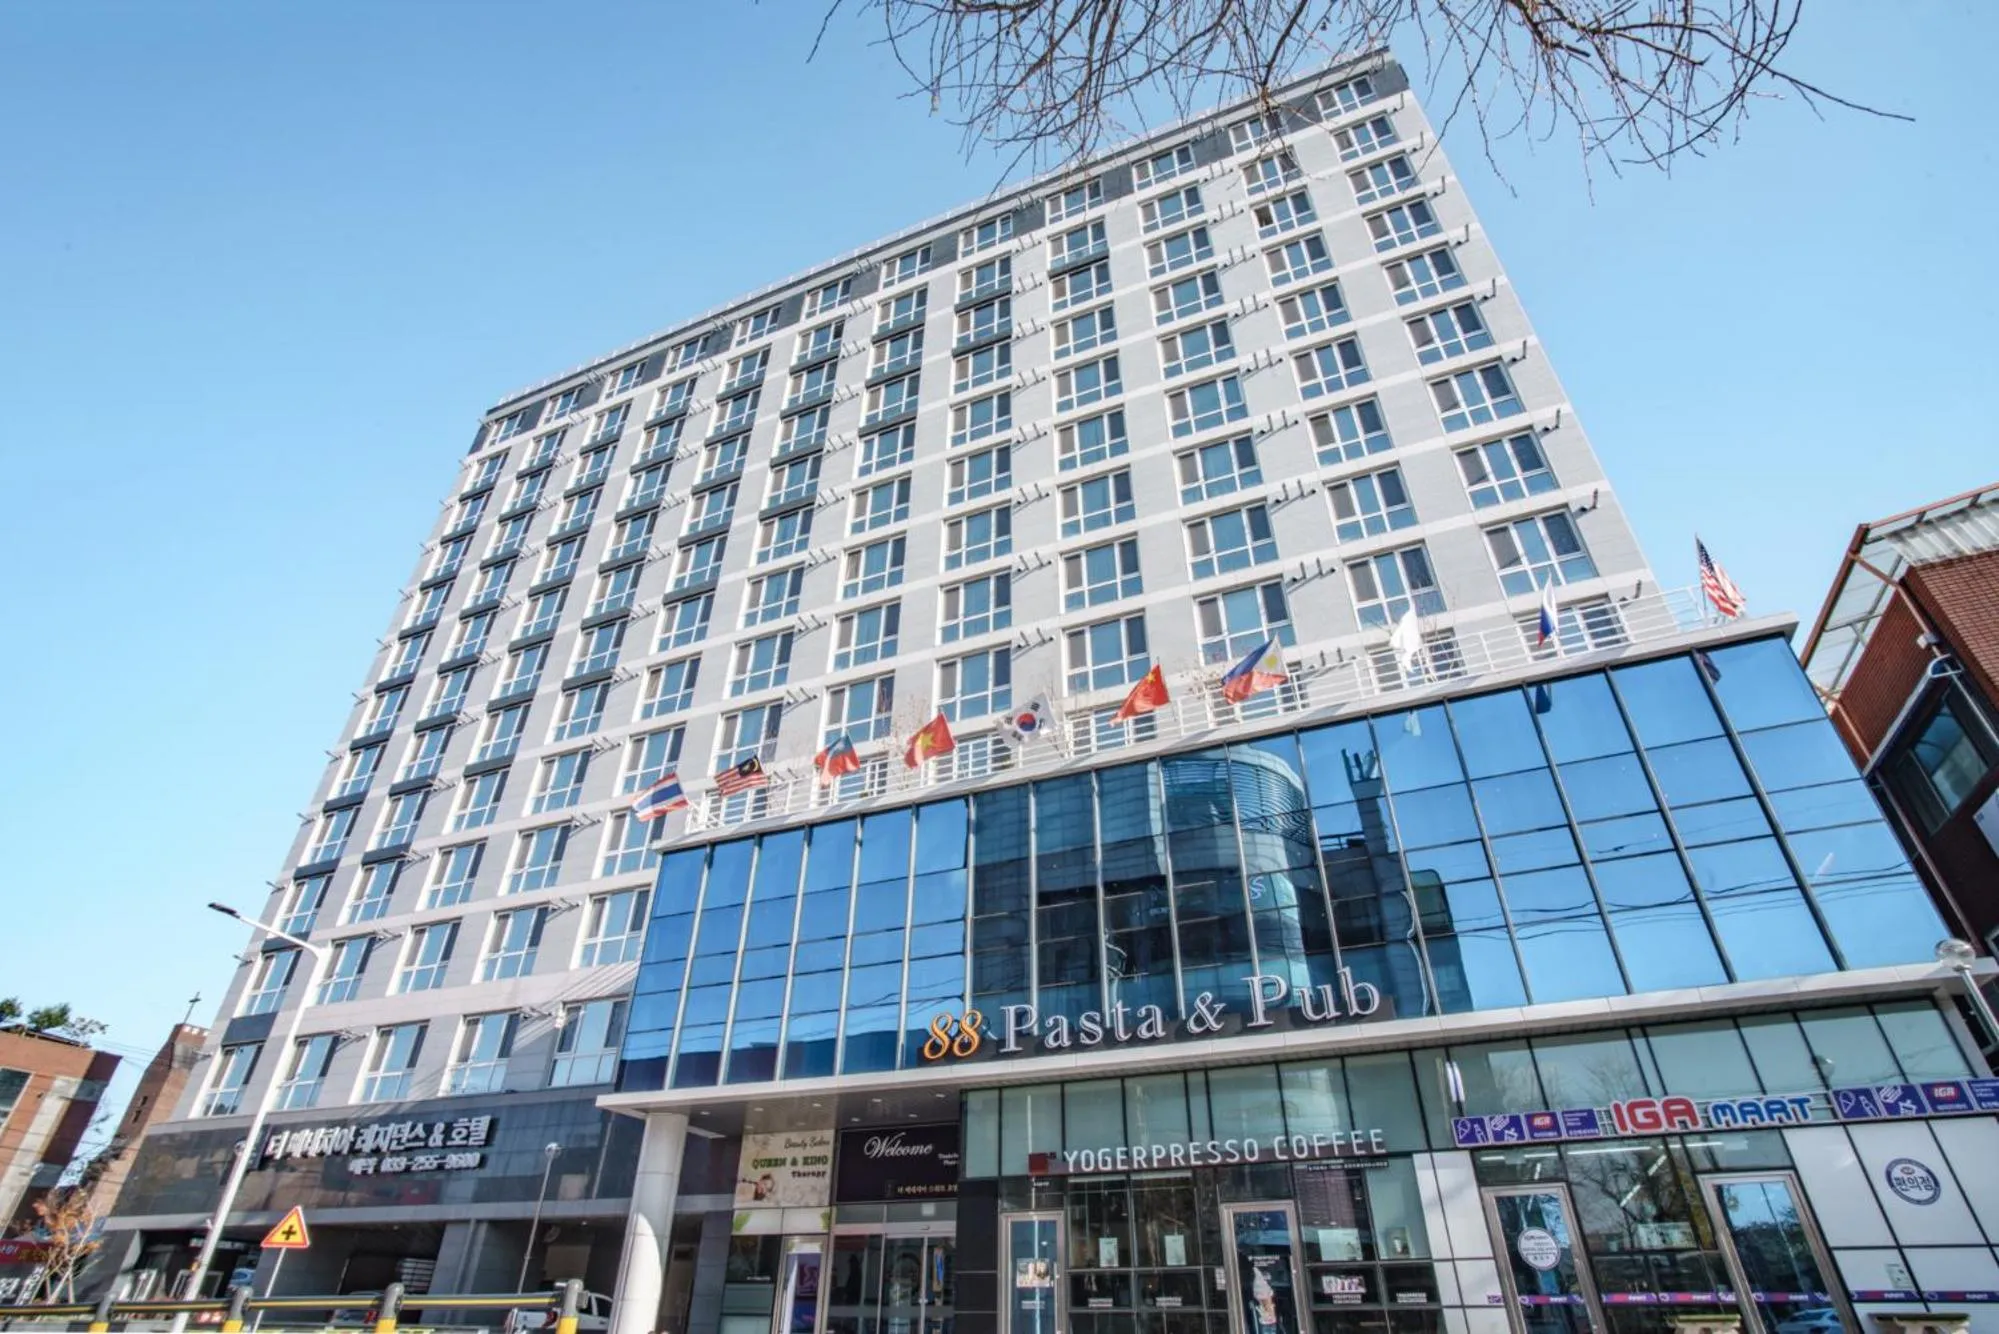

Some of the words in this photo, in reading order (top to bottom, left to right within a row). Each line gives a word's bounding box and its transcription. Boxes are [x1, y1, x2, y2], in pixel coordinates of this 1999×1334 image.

[923, 1009, 983, 1061] 88
[999, 1000, 1167, 1053] Pasta
[1186, 991, 1226, 1034] &
[1241, 967, 1381, 1028] Pub
[1612, 1097, 1701, 1133] IGA
[1710, 1096, 1812, 1127] MART
[355, 1120, 426, 1151] 레지던스
[427, 1121, 445, 1147] &
[447, 1115, 492, 1147] 호텔
[864, 1132, 934, 1159] Welcome
[1063, 1138, 1259, 1174] YOGERPRESSO
[1274, 1128, 1388, 1161] COFFEE
[751, 1157, 788, 1170] QUEEN
[802, 1155, 829, 1167] KING
[1893, 1175, 1934, 1192] 편의점
